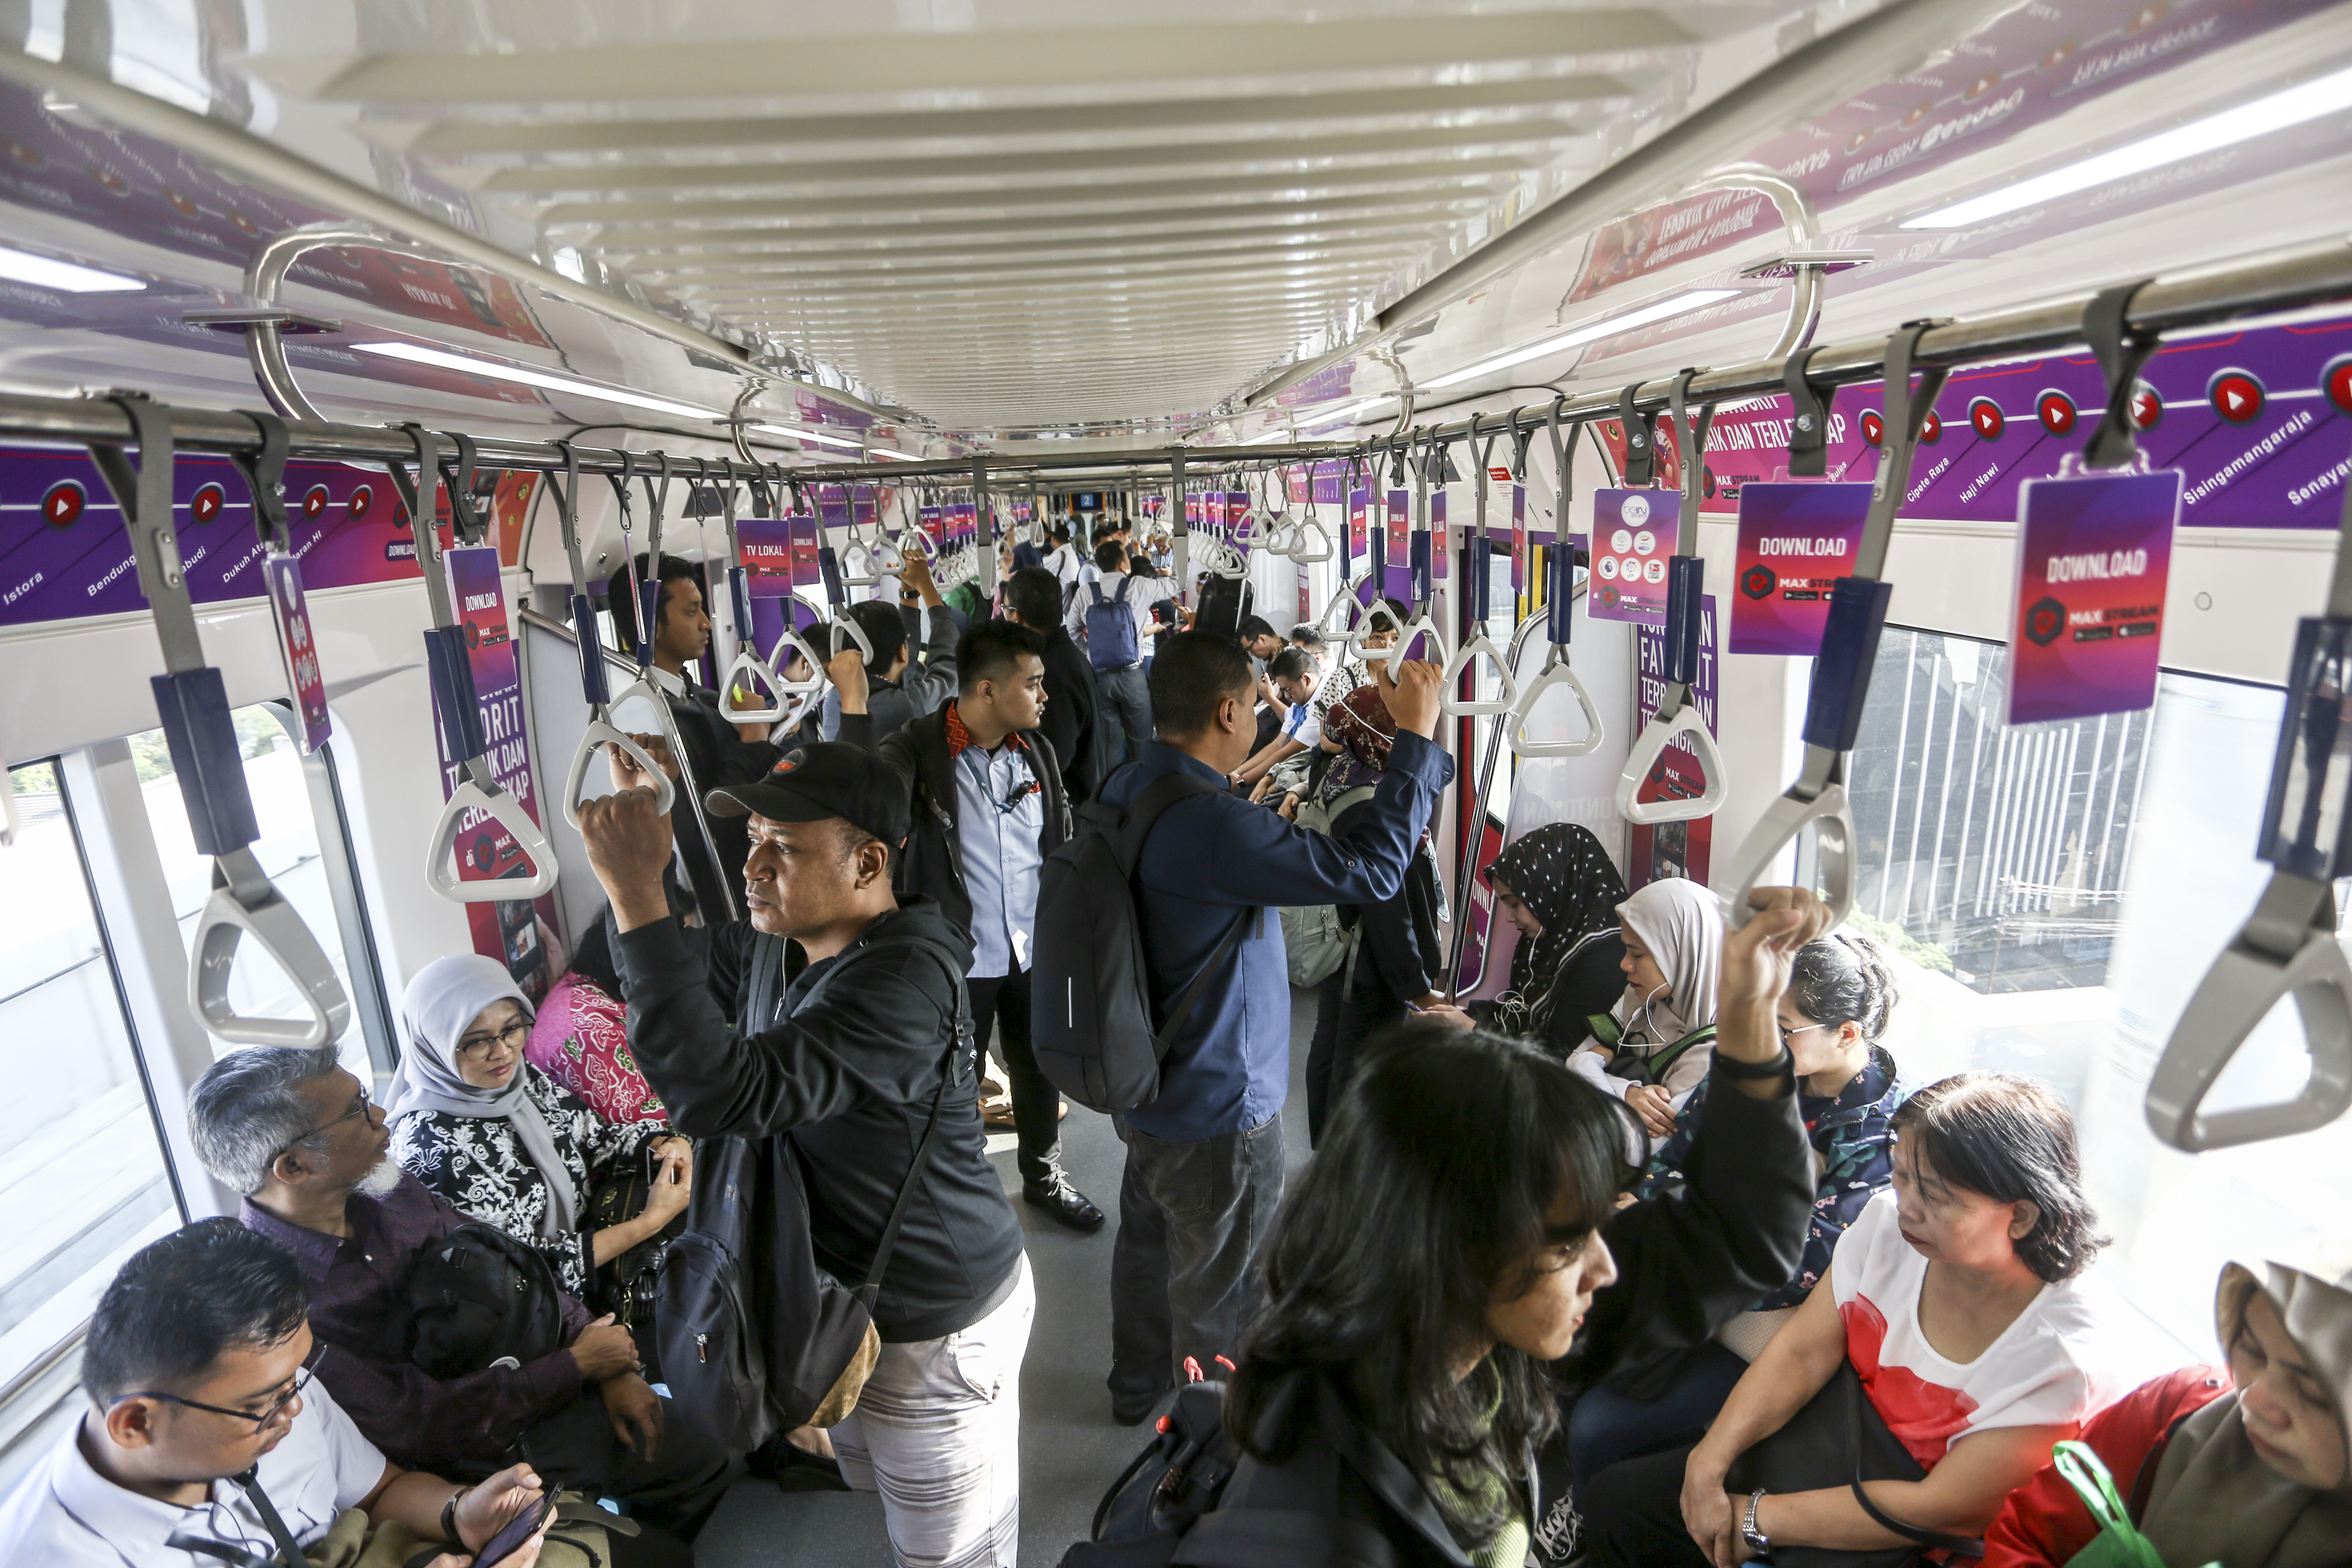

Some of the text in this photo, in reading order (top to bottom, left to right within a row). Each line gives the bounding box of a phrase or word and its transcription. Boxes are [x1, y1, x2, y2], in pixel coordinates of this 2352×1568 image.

[1724, 424, 1755, 450] DAN
[2183, 410, 2313, 505] Sisingamangaraja
[1830, 461, 1847, 483] Bulus
[1906, 457, 1950, 503] Cipete Raya
[1959, 463, 1999, 504] Haji Nawi
[1084, 495, 1090, 505] 2
[1391, 513, 1405, 523] DOWNLOAD
[312, 530, 322, 543] HI
[793, 538, 813, 546] DOWNLOAD
[1759, 537, 1847, 556] DOWNLOAD
[181, 546, 206, 574] abudi
[222, 541, 266, 583] Dukuh Ata
[746, 545, 784, 556] TV LOKAL
[87, 554, 138, 597] Bendung
[2046, 549, 2148, 584] DOWNLOAD
[3, 571, 44, 606] Istora
[1779, 578, 1835, 588] MAXSTR
[465, 592, 497, 612] DOWNLOAD
[502, 737, 526, 773] DAN
[466, 849, 475, 867] di
